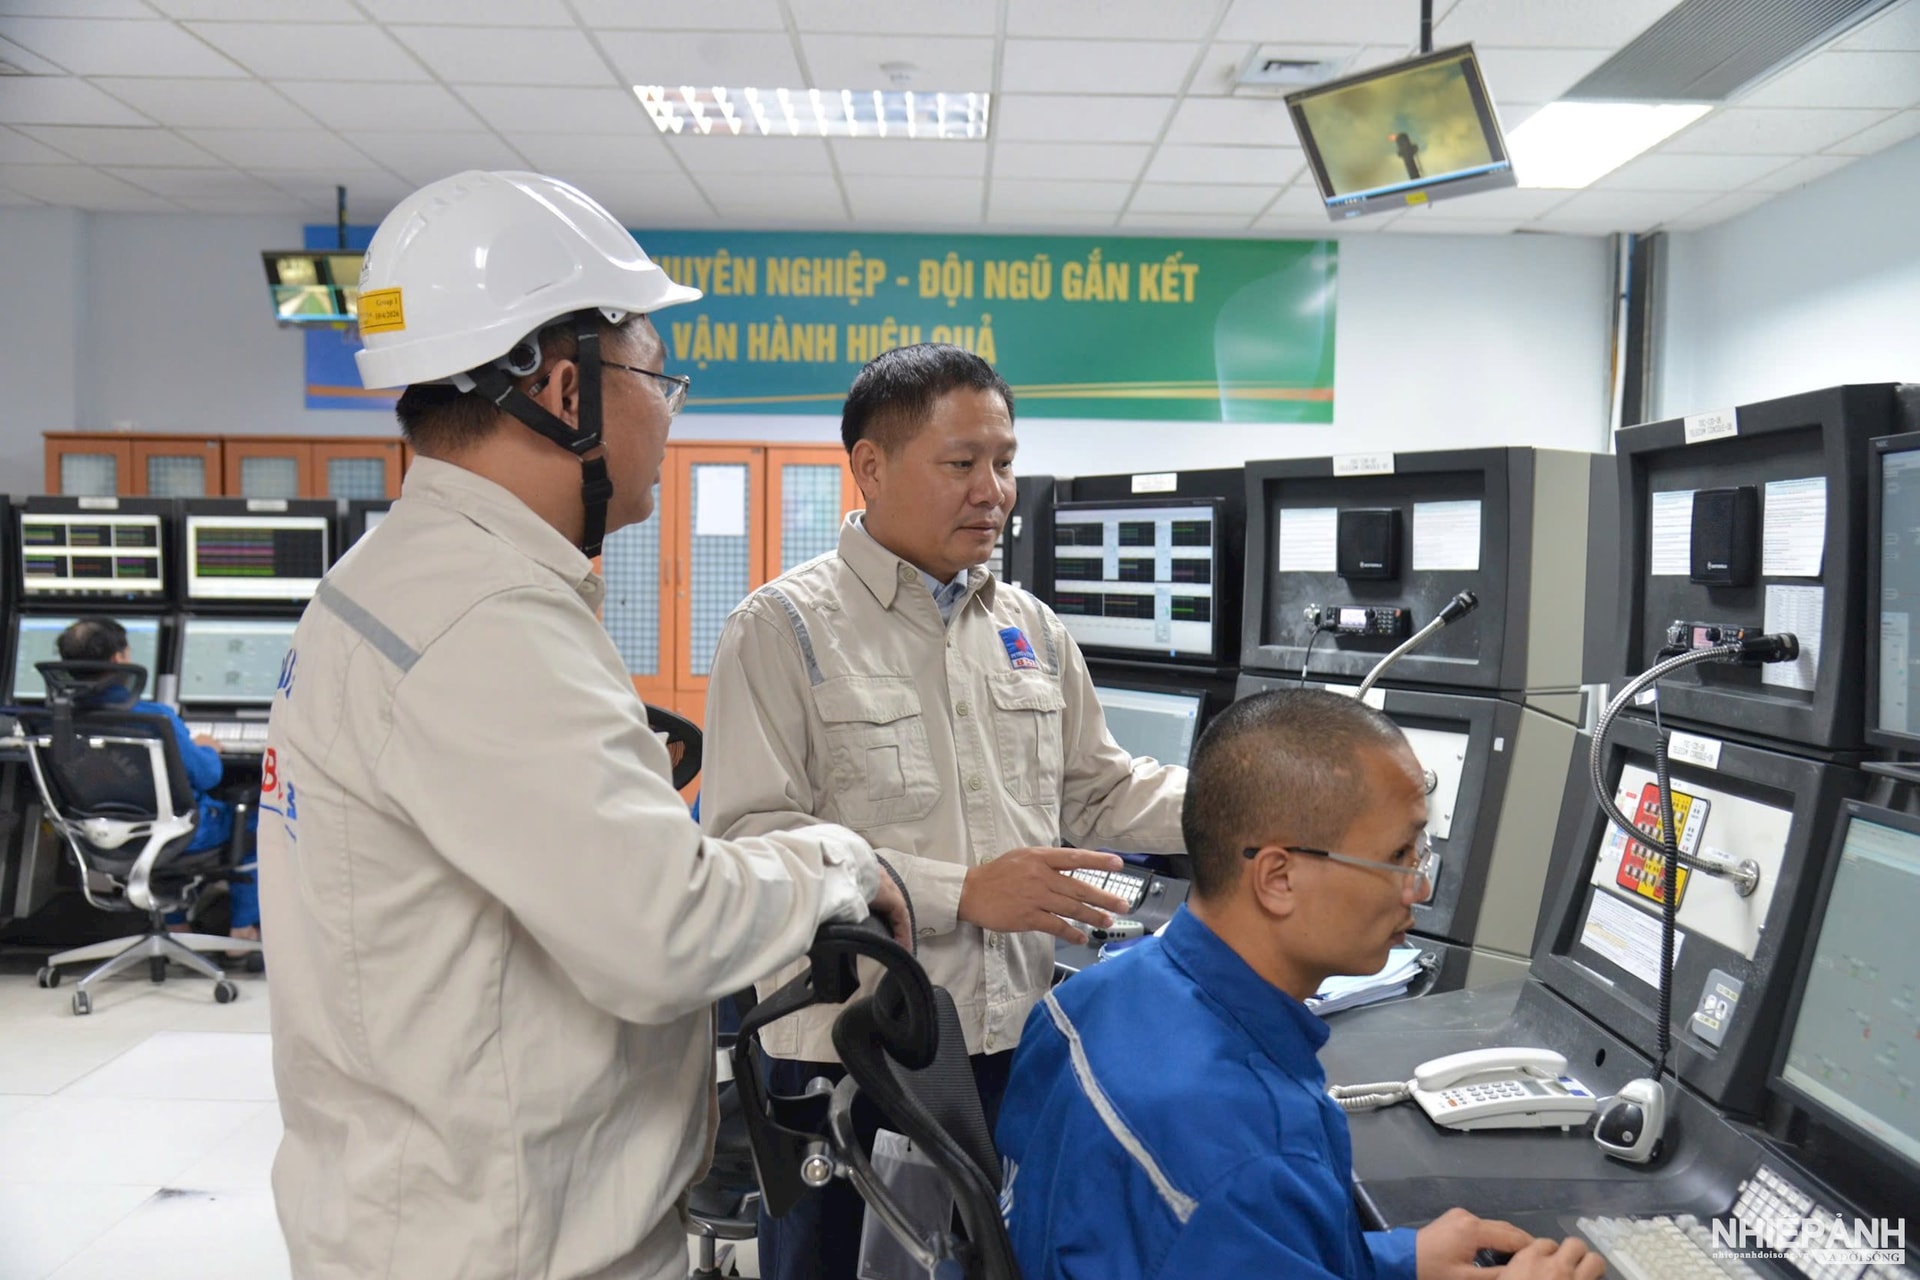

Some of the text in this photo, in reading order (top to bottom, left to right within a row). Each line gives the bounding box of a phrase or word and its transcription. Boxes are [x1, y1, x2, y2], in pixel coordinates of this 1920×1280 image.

[766, 249, 887, 306] NGHIỆP
[918, 251, 974, 308] ĐỘI
[984, 253, 1052, 301] NGŨ
[1062, 247, 1130, 301] GẮN
[1140, 250, 1200, 303] KẾT
[672, 313, 738, 370] VẬN
[747, 314, 837, 363] HÀNH
